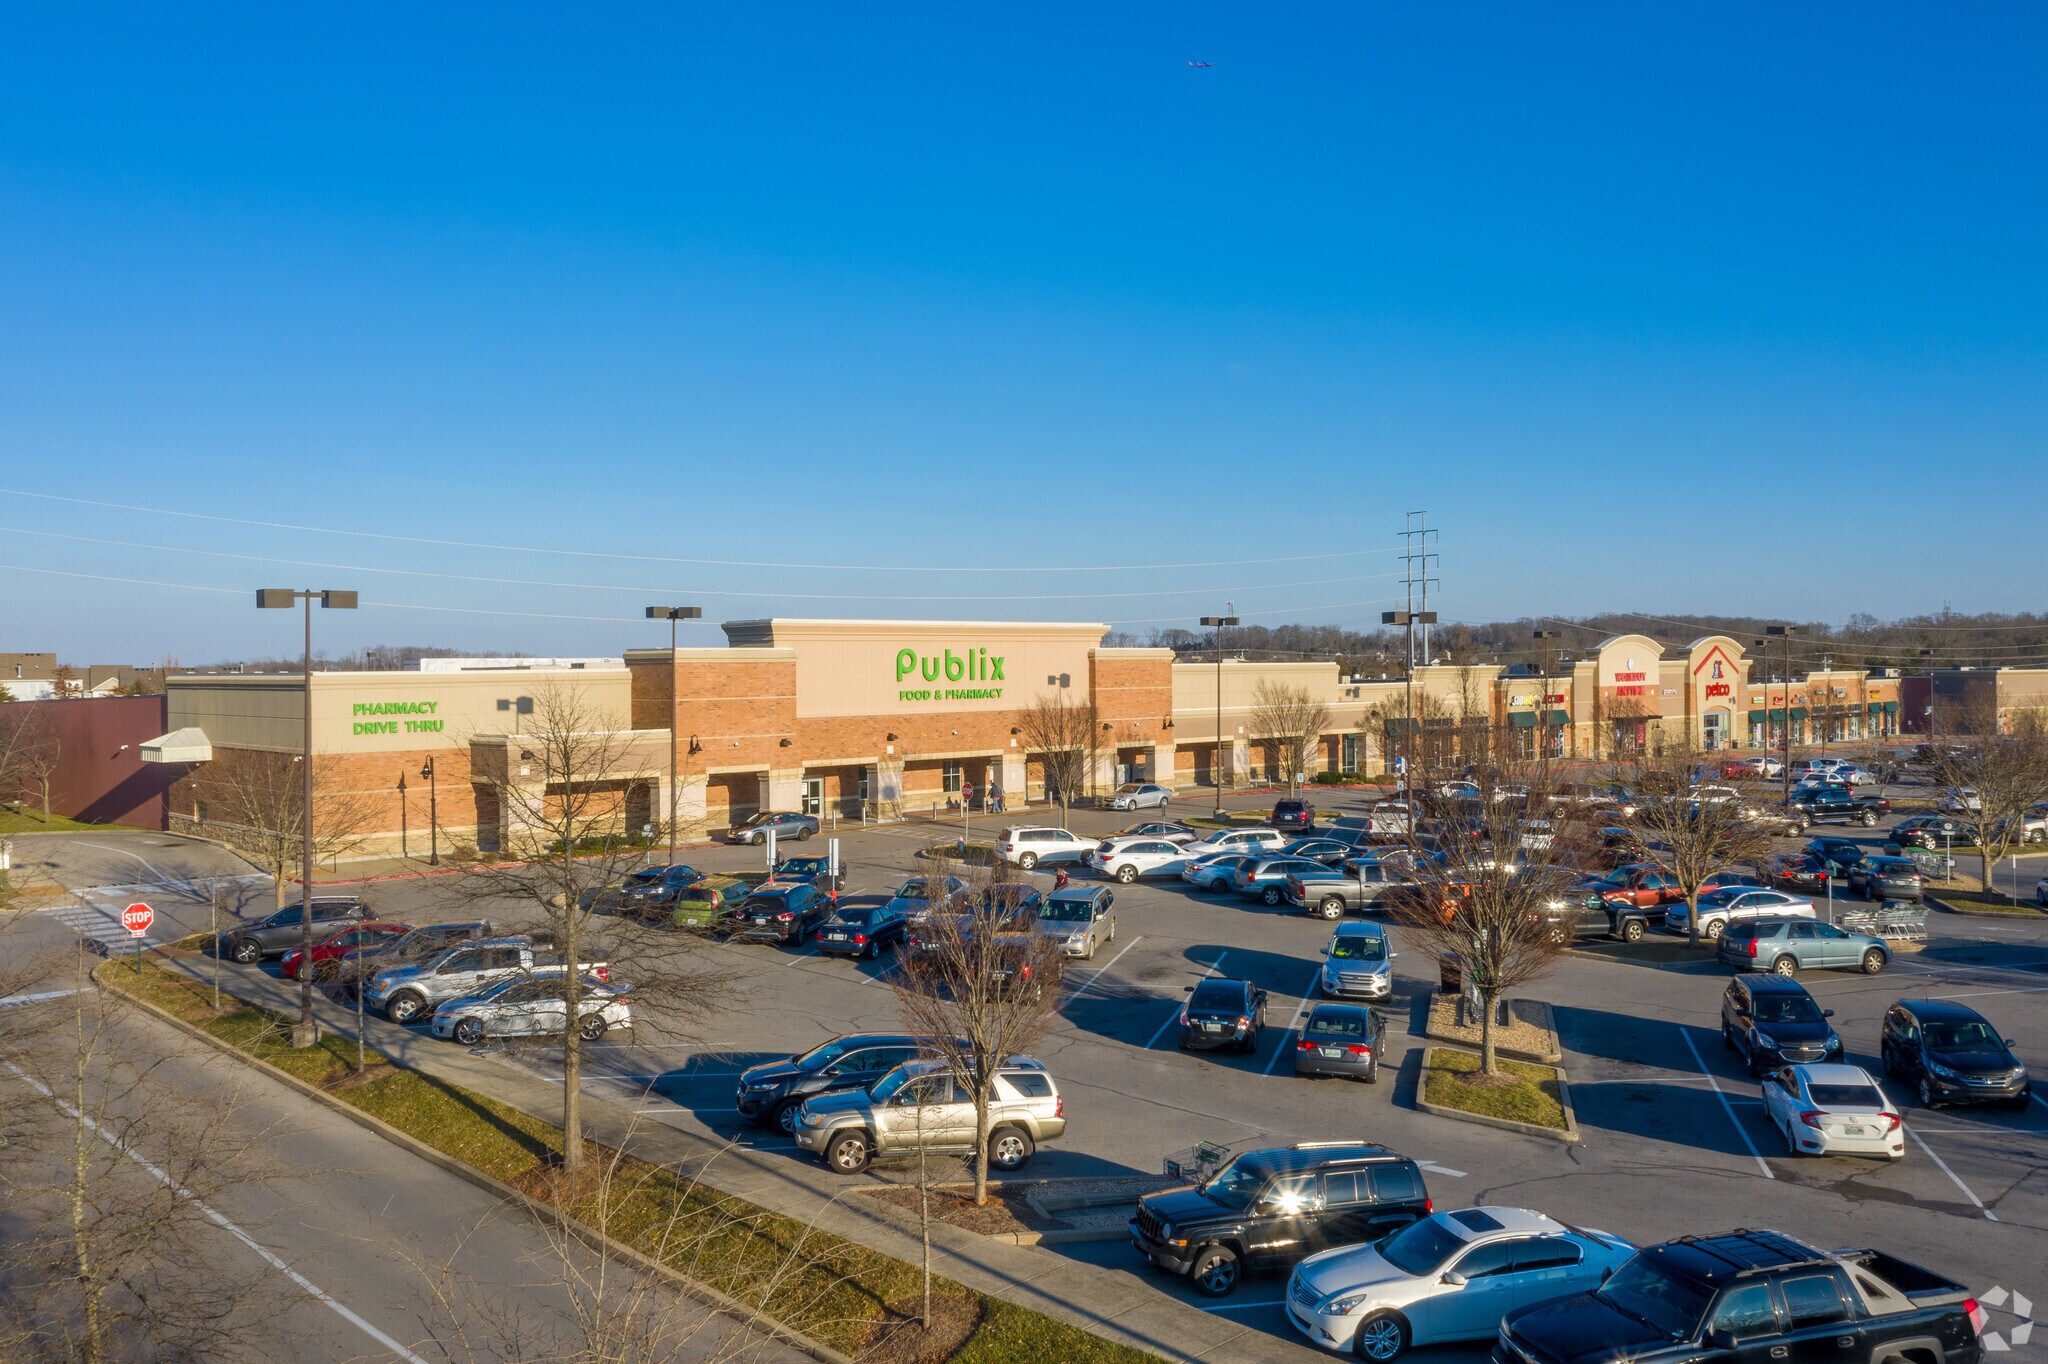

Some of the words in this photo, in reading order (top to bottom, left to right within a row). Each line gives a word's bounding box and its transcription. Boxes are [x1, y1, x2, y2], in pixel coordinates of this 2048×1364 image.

[896, 647, 1005, 682] Publix
[1615, 672, 1646, 683] WORKOUT
[899, 690, 931, 701] FOOD
[934, 690, 942, 700] &
[945, 688, 1002, 700] PHARMACY
[1705, 682, 1730, 701] petco
[1511, 693, 1537, 707] SUBWAY
[353, 701, 438, 716] PHARMACY
[353, 721, 398, 735] DRIVE
[404, 719, 444, 733] THRU
[124, 911, 151, 924] STOP
